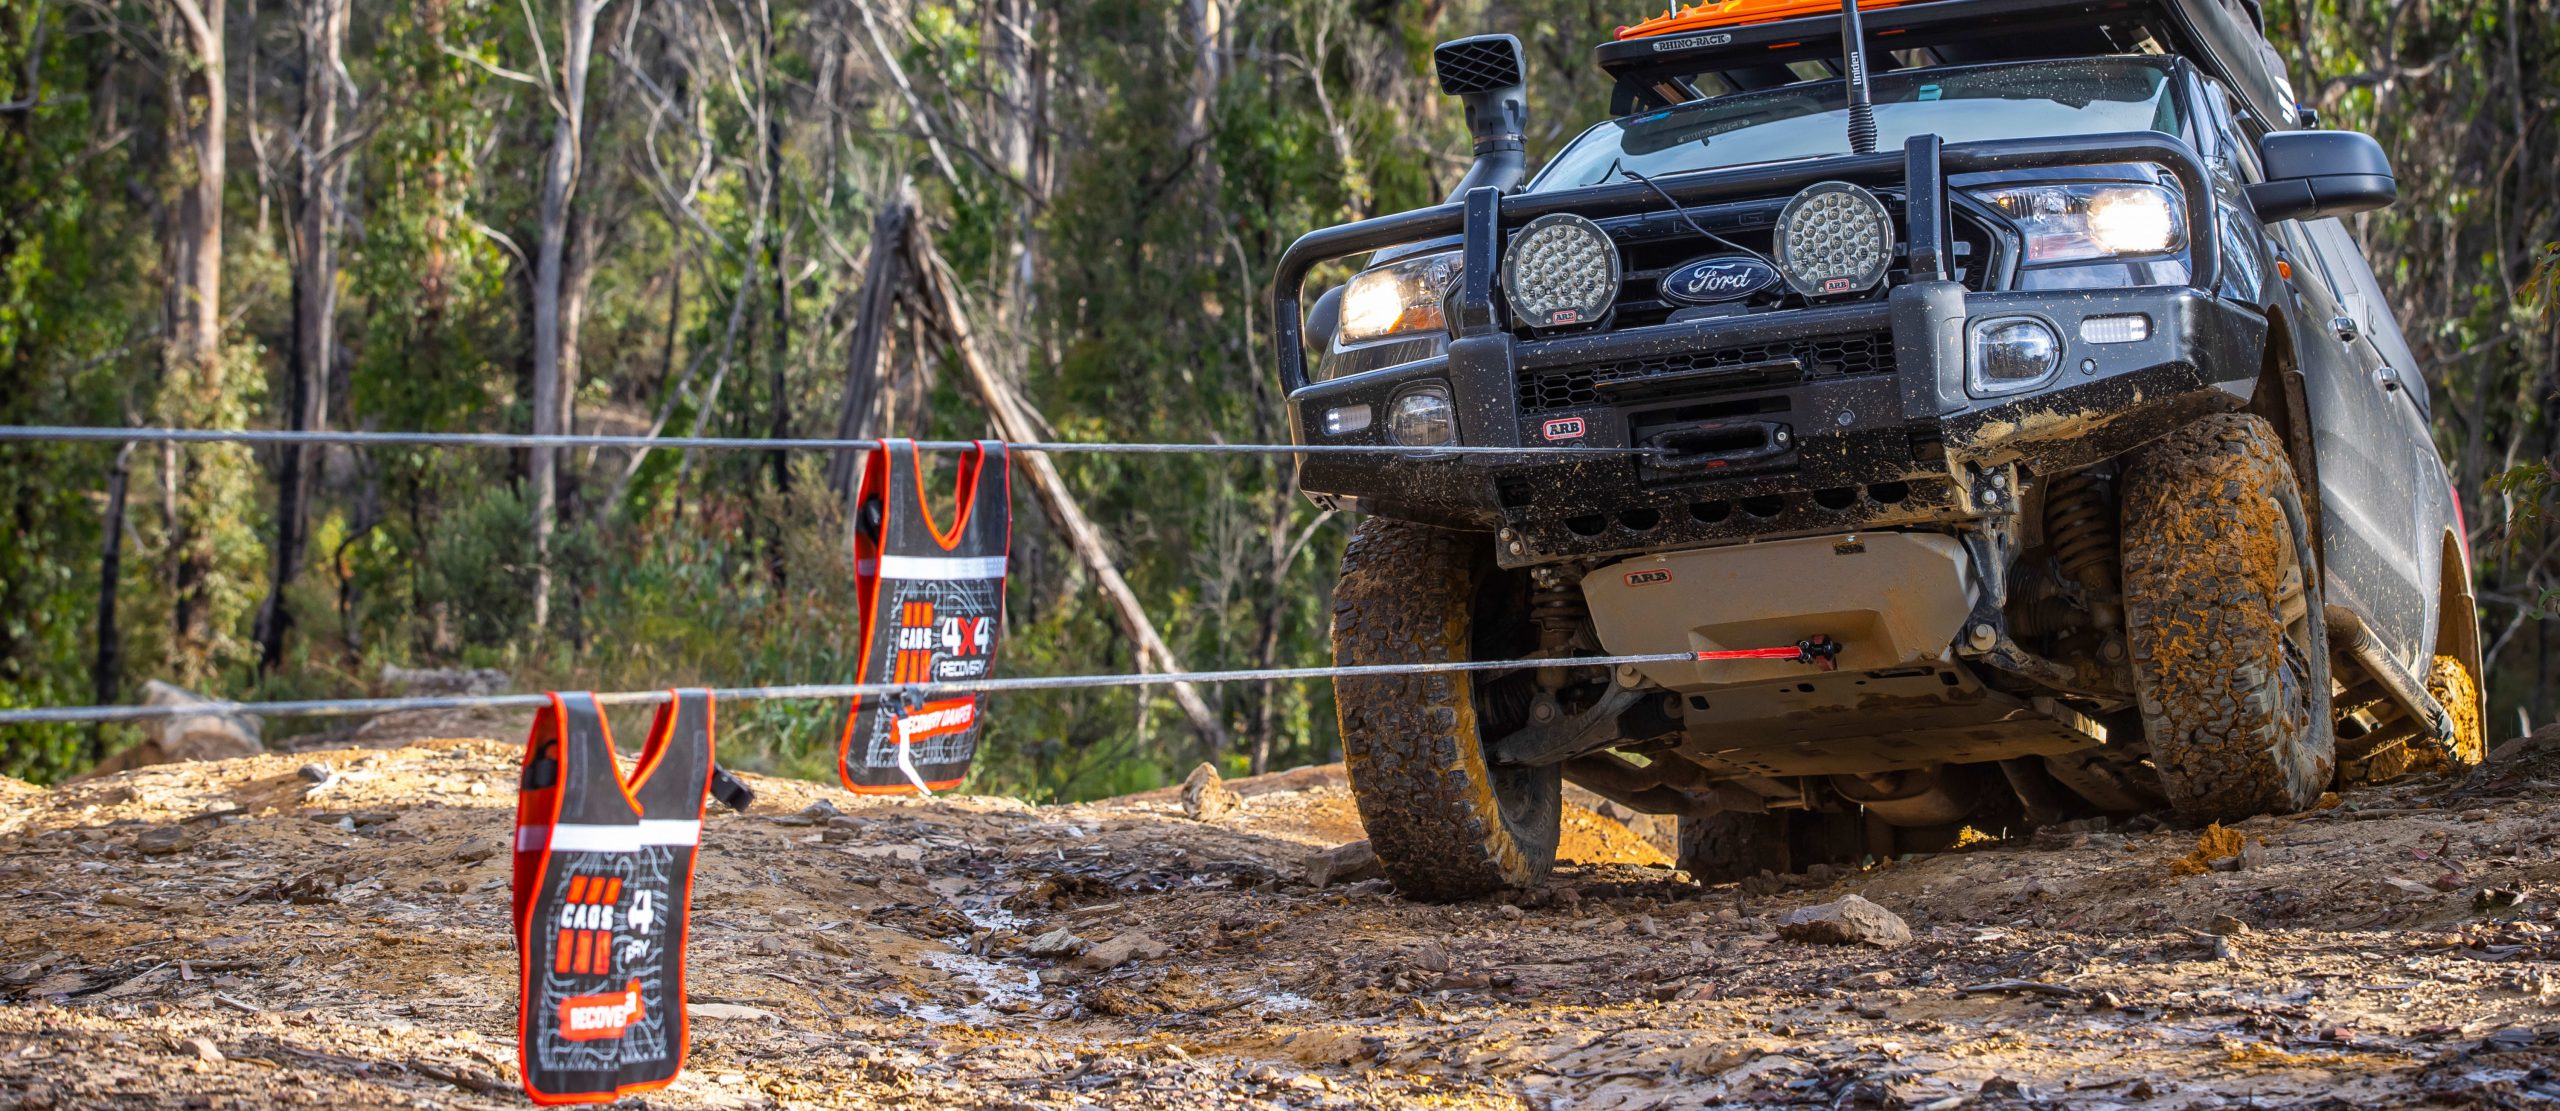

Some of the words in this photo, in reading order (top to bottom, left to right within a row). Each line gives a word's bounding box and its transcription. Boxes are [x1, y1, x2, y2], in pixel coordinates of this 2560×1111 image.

[1659, 34, 1727, 51] RHINO-RACK
[1850, 51, 1862, 86] Uniden
[1688, 263, 1752, 292] Ford
[1828, 281, 1848, 290] ARB
[1549, 422, 1581, 436] ARB
[1630, 571, 1668, 585] ARB
[939, 658, 987, 677] RECOVERY
[560, 903, 614, 931] CAOS
